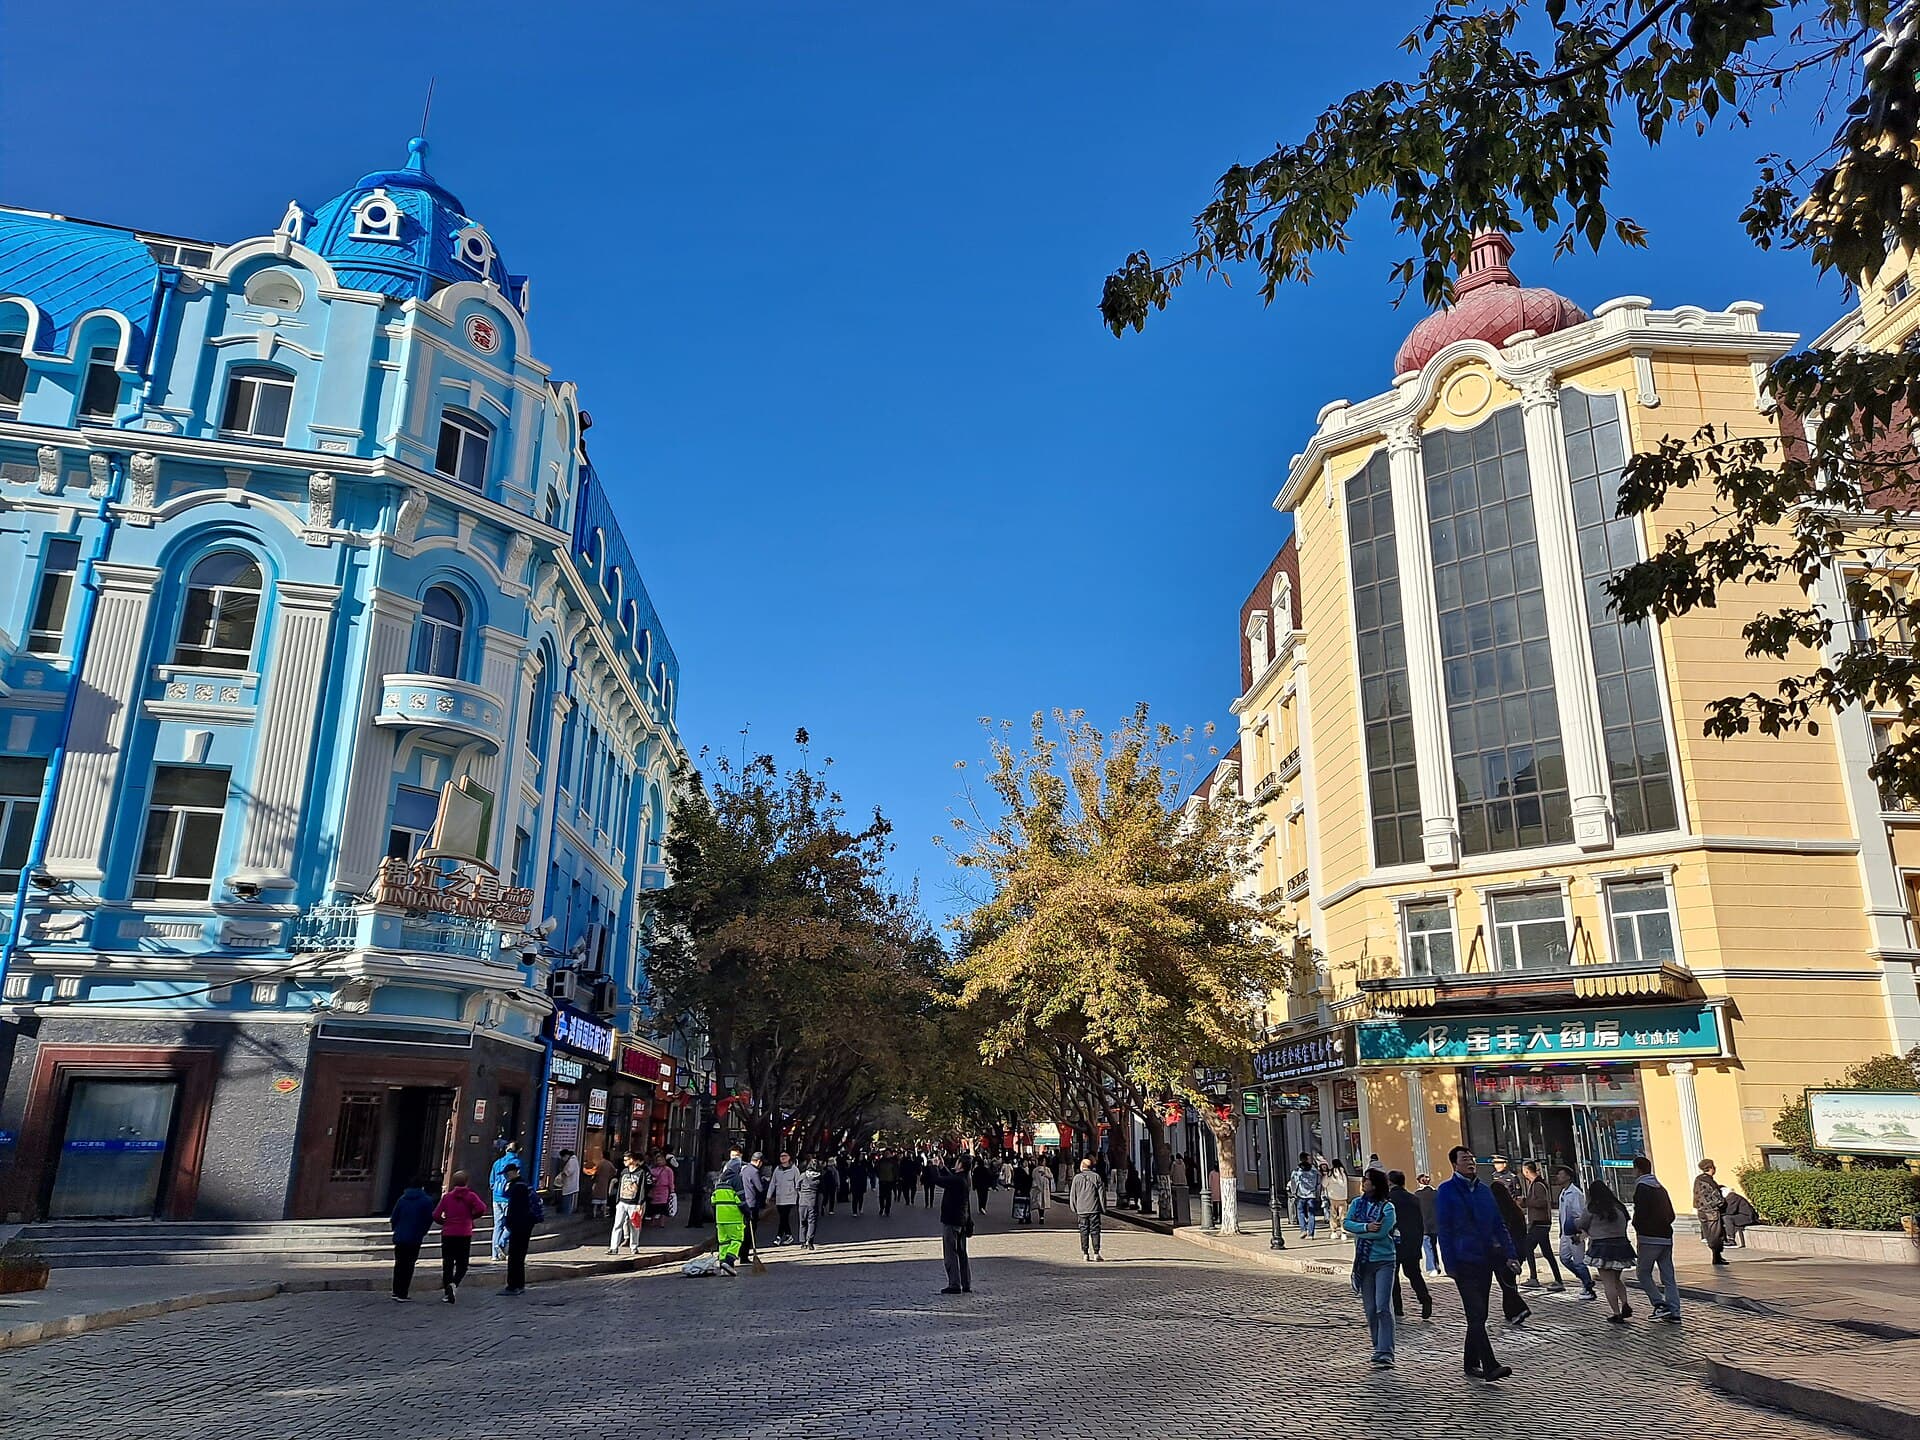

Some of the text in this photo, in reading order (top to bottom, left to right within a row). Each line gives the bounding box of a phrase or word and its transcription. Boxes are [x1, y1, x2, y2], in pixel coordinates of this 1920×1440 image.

[386, 861, 534, 906] 锦江之星 品尚
[459, 899, 487, 916] INN
[494, 905, 531, 922] Select
[1467, 1020, 1680, 1051] 宝丰大药房 红旗店
